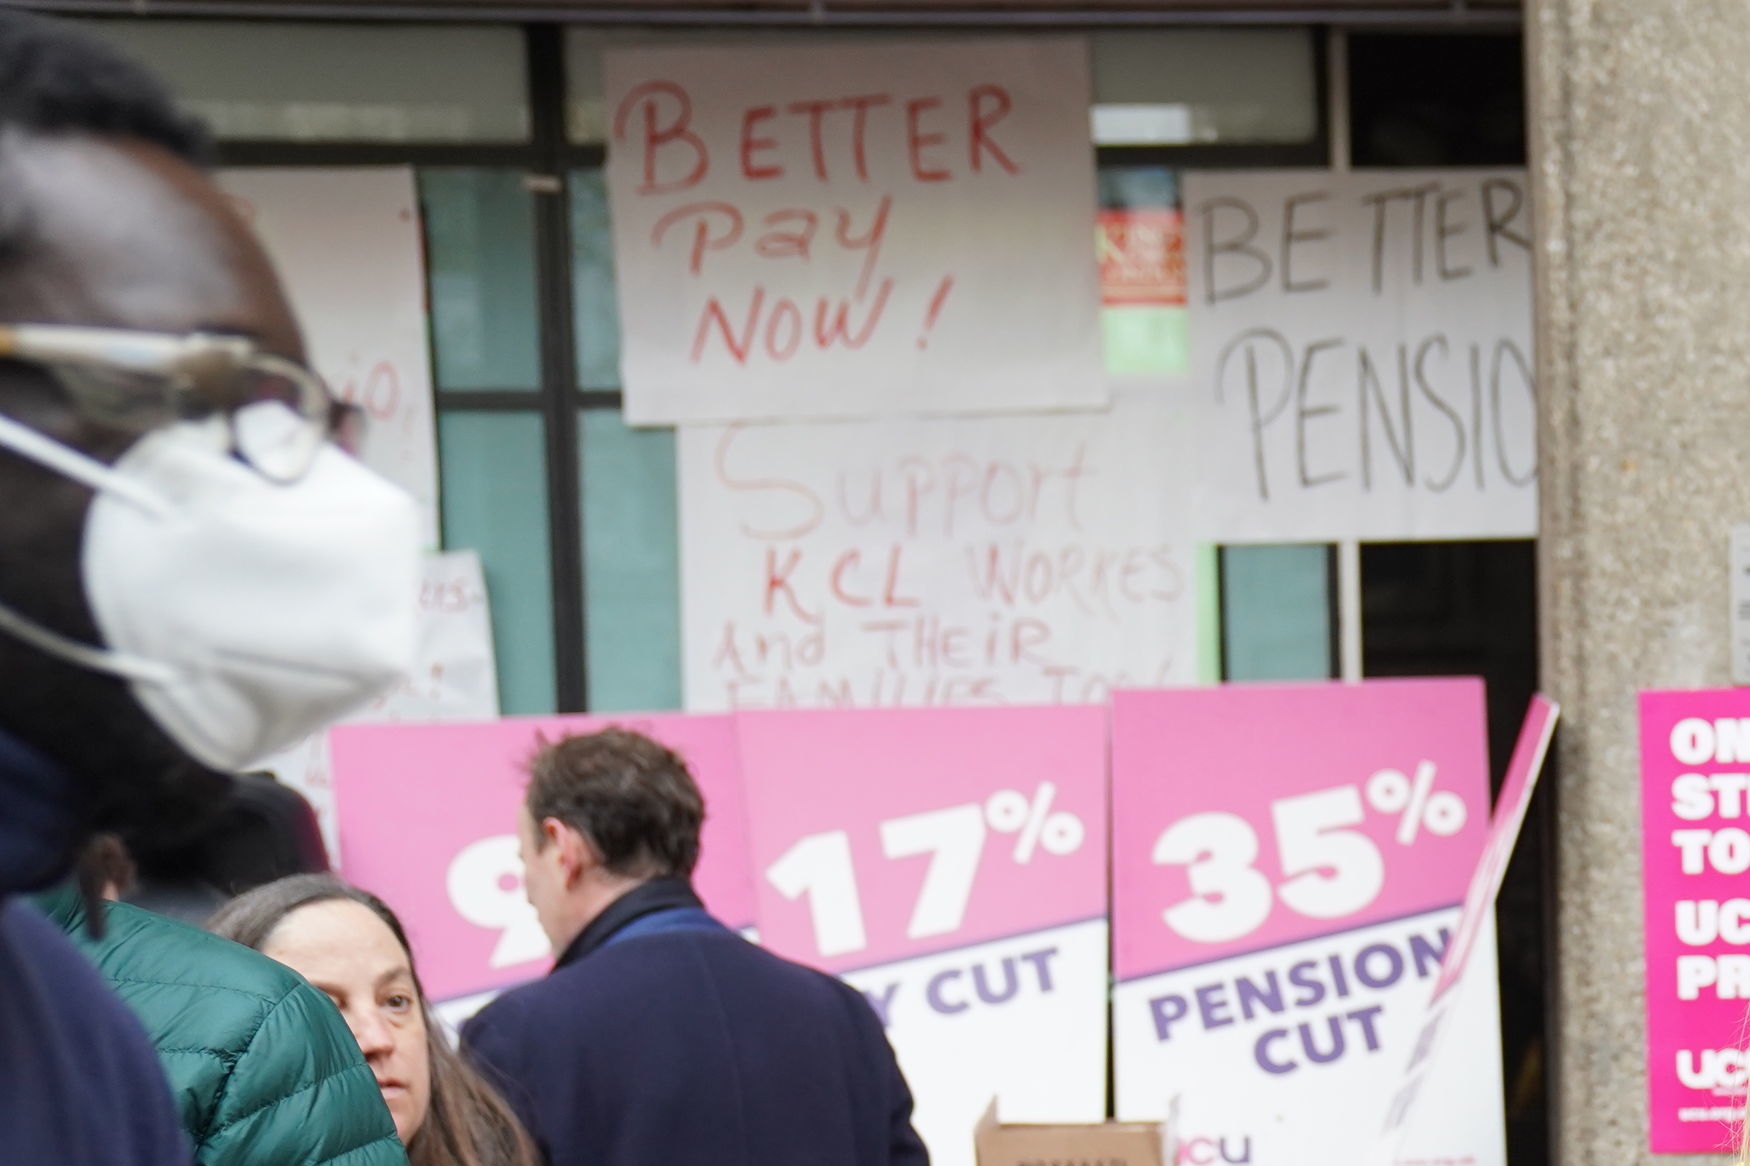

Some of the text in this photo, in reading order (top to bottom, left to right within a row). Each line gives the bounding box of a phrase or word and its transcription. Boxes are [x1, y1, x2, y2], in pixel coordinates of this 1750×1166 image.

[613, 79, 1022, 196] BETTER
[1201, 178, 1534, 309] BETTER
[1215, 326, 1538, 501] PENSIO
[763, 544, 921, 624] KCL
[765, 781, 1084, 957] 17%
[1151, 759, 1467, 943] 35%
[925, 947, 1058, 1016] CUT
[1148, 926, 1454, 1043] PENSION
[1253, 1003, 1384, 1076] CUT
